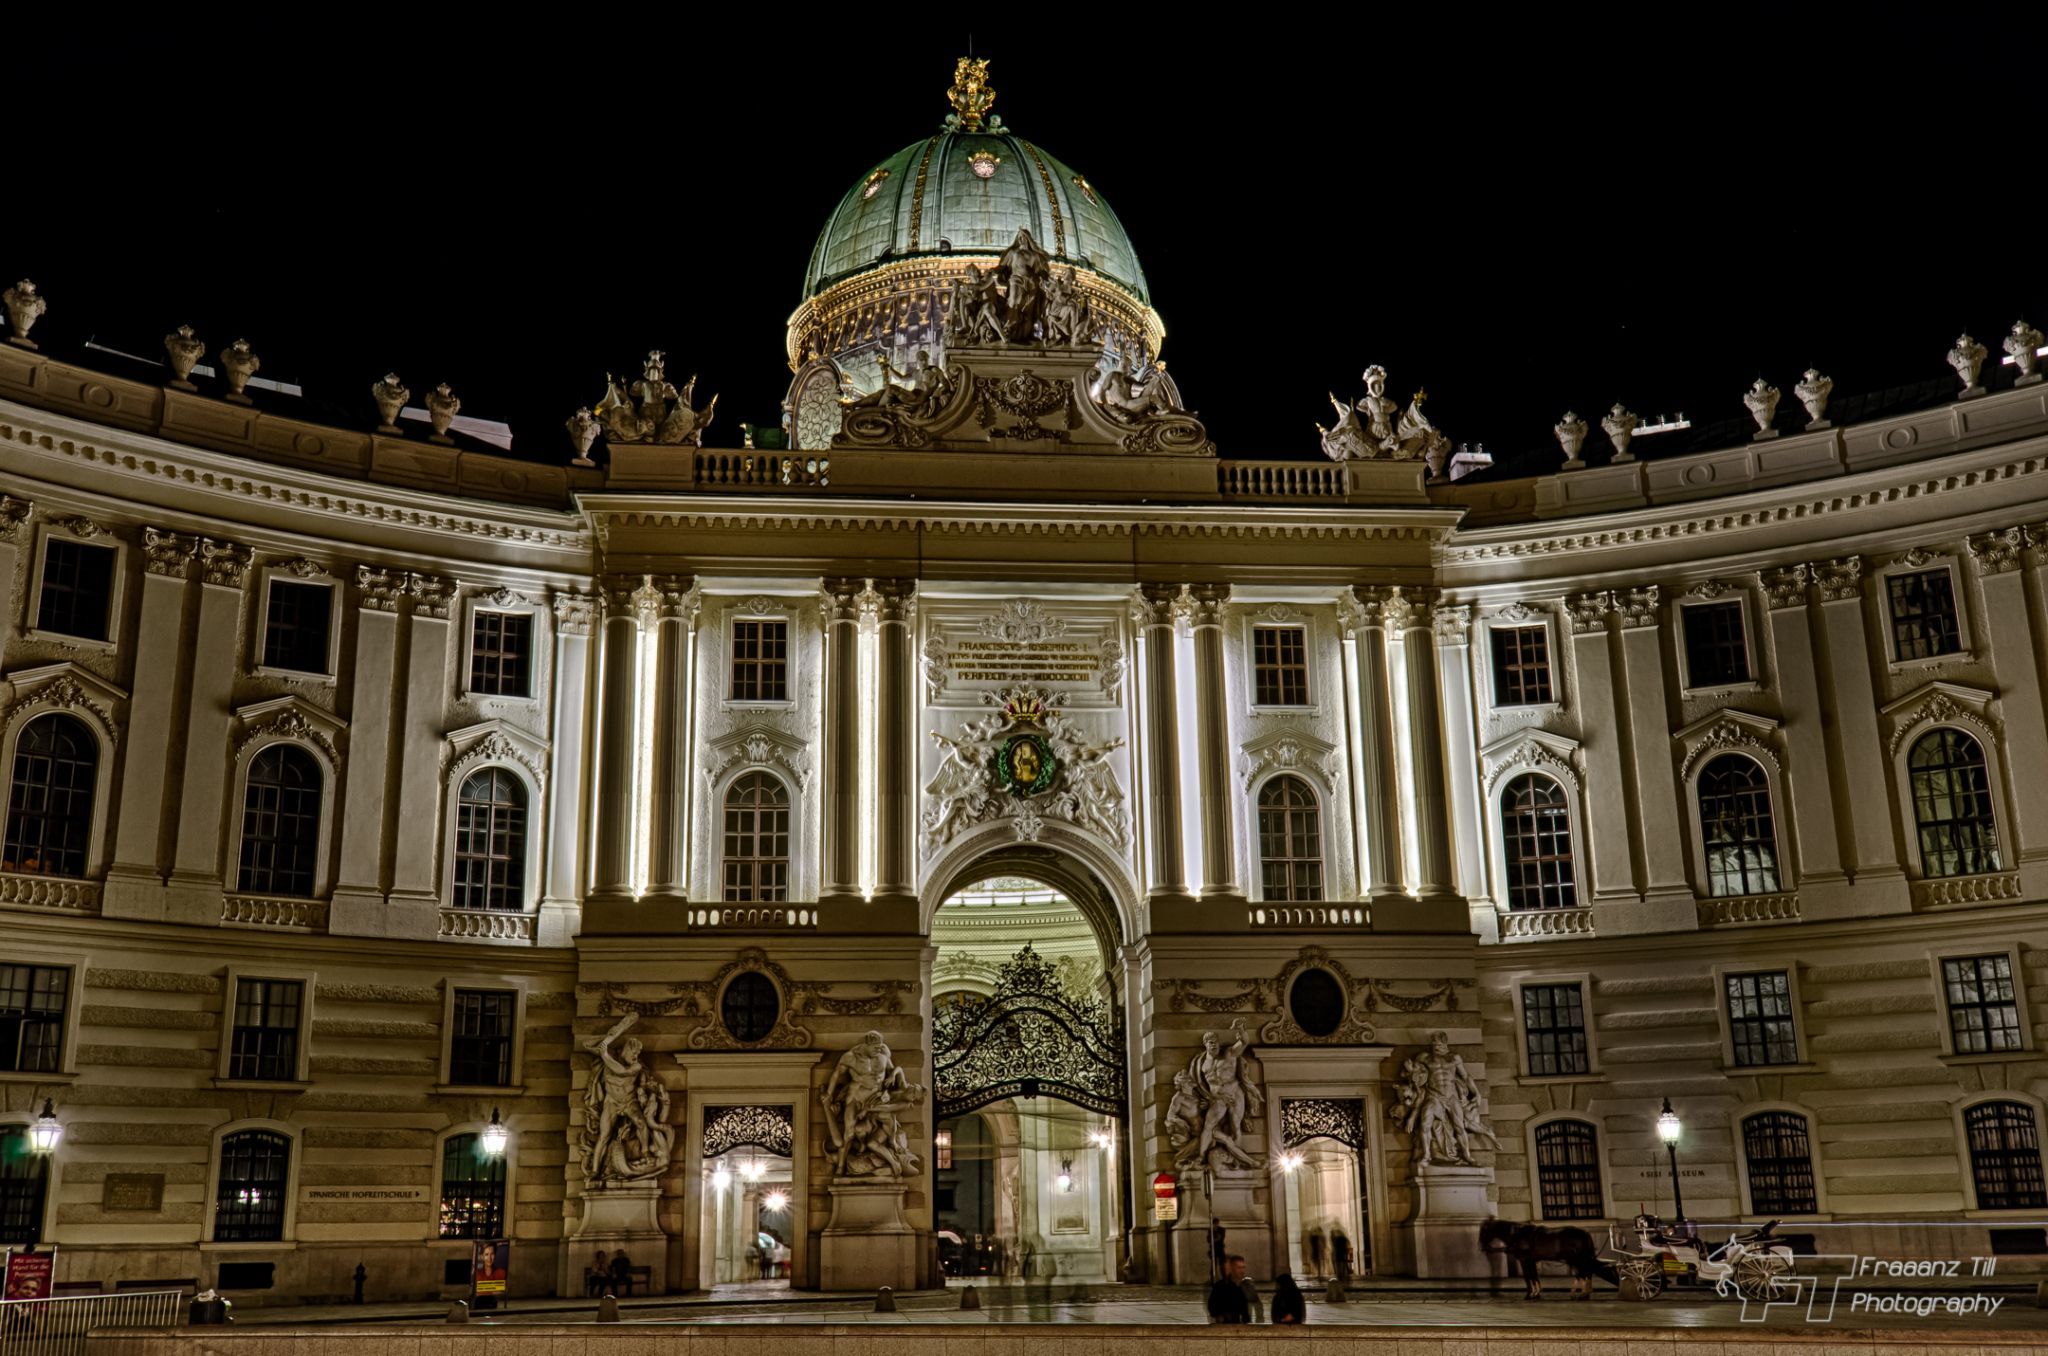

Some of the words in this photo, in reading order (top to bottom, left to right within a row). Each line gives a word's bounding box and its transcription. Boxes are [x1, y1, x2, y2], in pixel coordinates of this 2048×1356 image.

[958, 642, 1022, 651] FRANCISCVS
[309, 1191, 350, 1199] SPANISCHE
[352, 1191, 412, 1199] HOFREITSCHULE
